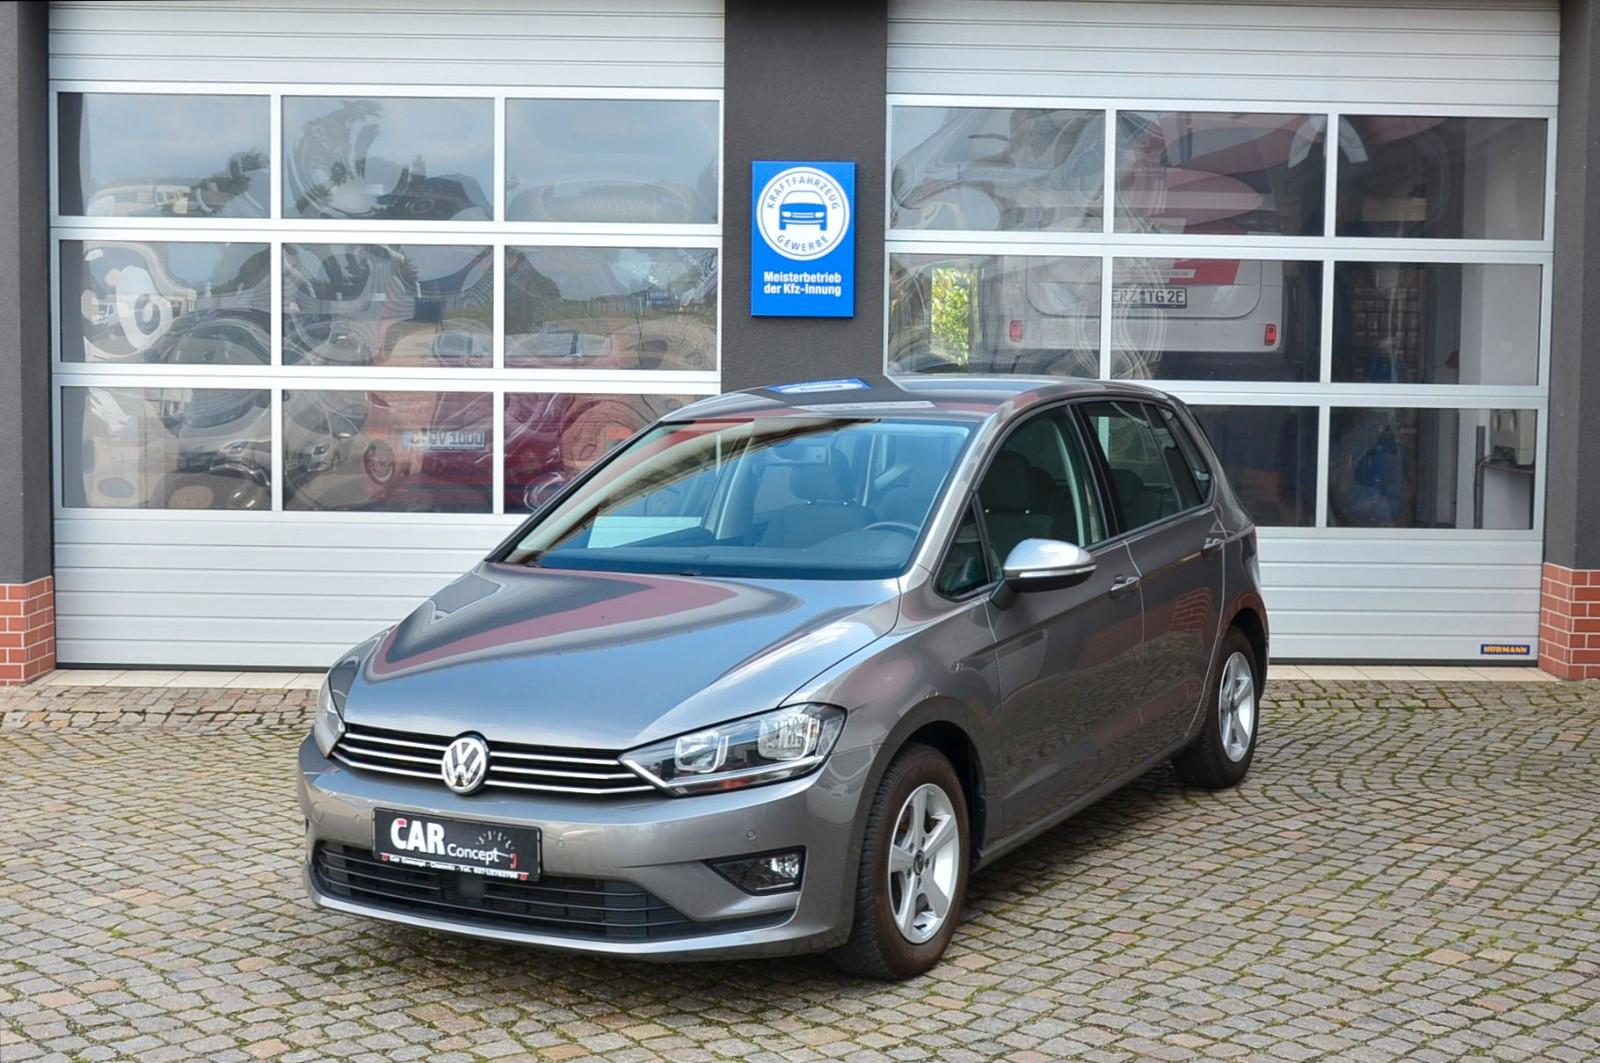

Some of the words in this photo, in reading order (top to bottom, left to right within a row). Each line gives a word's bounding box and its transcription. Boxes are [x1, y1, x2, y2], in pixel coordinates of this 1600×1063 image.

[766, 176, 841, 210] KRAFTFAHRZEUG
[776, 234, 830, 252] GEWERBE
[763, 271, 842, 284] Meisterbetrieb
[763, 283, 781, 295] der
[783, 283, 842, 297] Kfz-Innung
[390, 818, 446, 856] CAR
[447, 843, 500, 866] Concept
